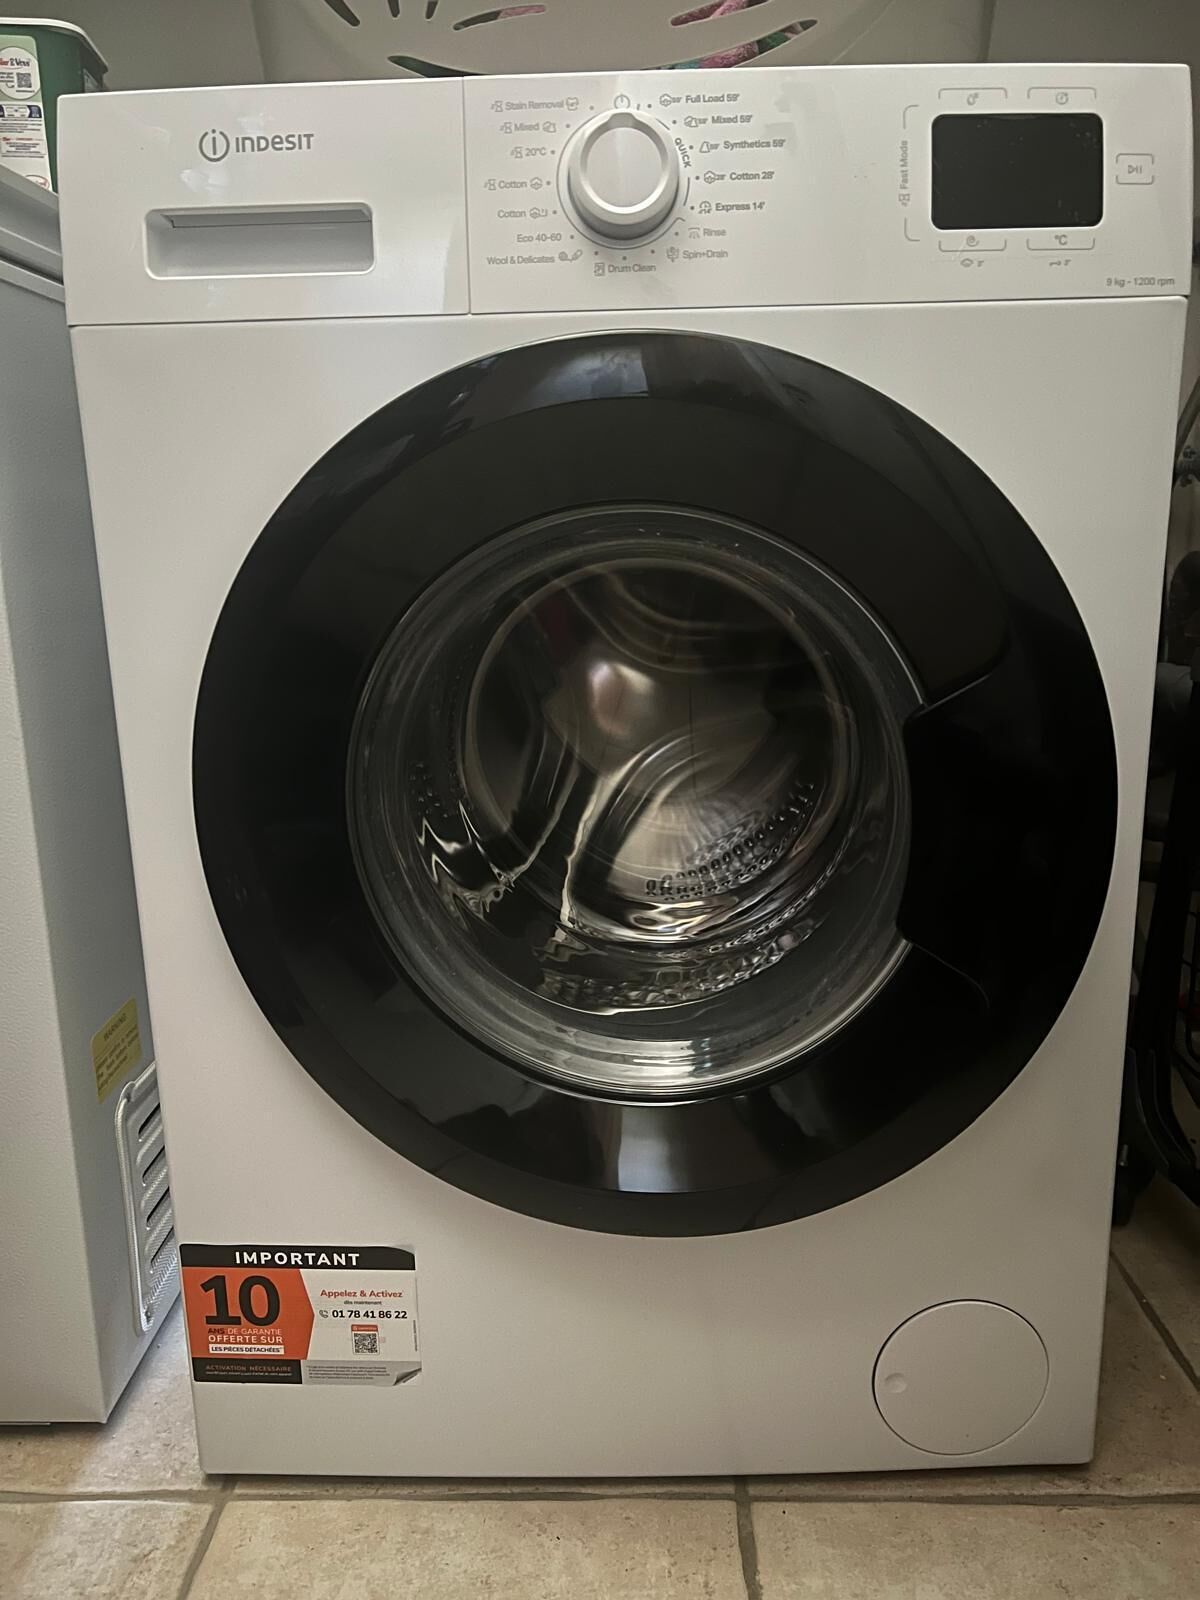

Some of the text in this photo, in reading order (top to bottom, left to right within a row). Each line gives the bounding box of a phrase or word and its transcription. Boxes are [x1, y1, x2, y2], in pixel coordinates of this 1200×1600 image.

[686, 94, 701, 104] Full
[702, 94, 724, 103] Load
[505, 100, 564, 110] Stain Removal
[712, 115, 738, 124] Mixed
[514, 122, 540, 132] Mixed
[723, 140, 771, 151] Synthetics
[525, 147, 546, 156] 20°C
[674, 138, 692, 168] QUICK
[900, 140, 908, 190] Fast Mode
[730, 172, 760, 180] Cotton
[498, 180, 528, 189] Cotton
[715, 202, 751, 212] Express
[497, 210, 526, 218] Cotton
[516, 232, 562, 242] Eco 40-60
[703, 228, 727, 237] Rinse
[486, 255, 555, 265] Wool & Delicates
[682, 250, 728, 260] Spin+Drain
[608, 263, 656, 274] Drum Clean
[1106, 278, 1112, 286] 9
[1114, 278, 1126, 288] kg
[1133, 276, 1156, 286] 1200
[1157, 278, 1175, 288] rpm
[235, 1252, 360, 1266] IMPORTANT
[320, 1289, 357, 1298] Appelez
[200, 1274, 281, 1326] 10
[332, 1310, 408, 1319] 01 78 41 86 22
[208, 1334, 283, 1344] OFFERTE SUR
